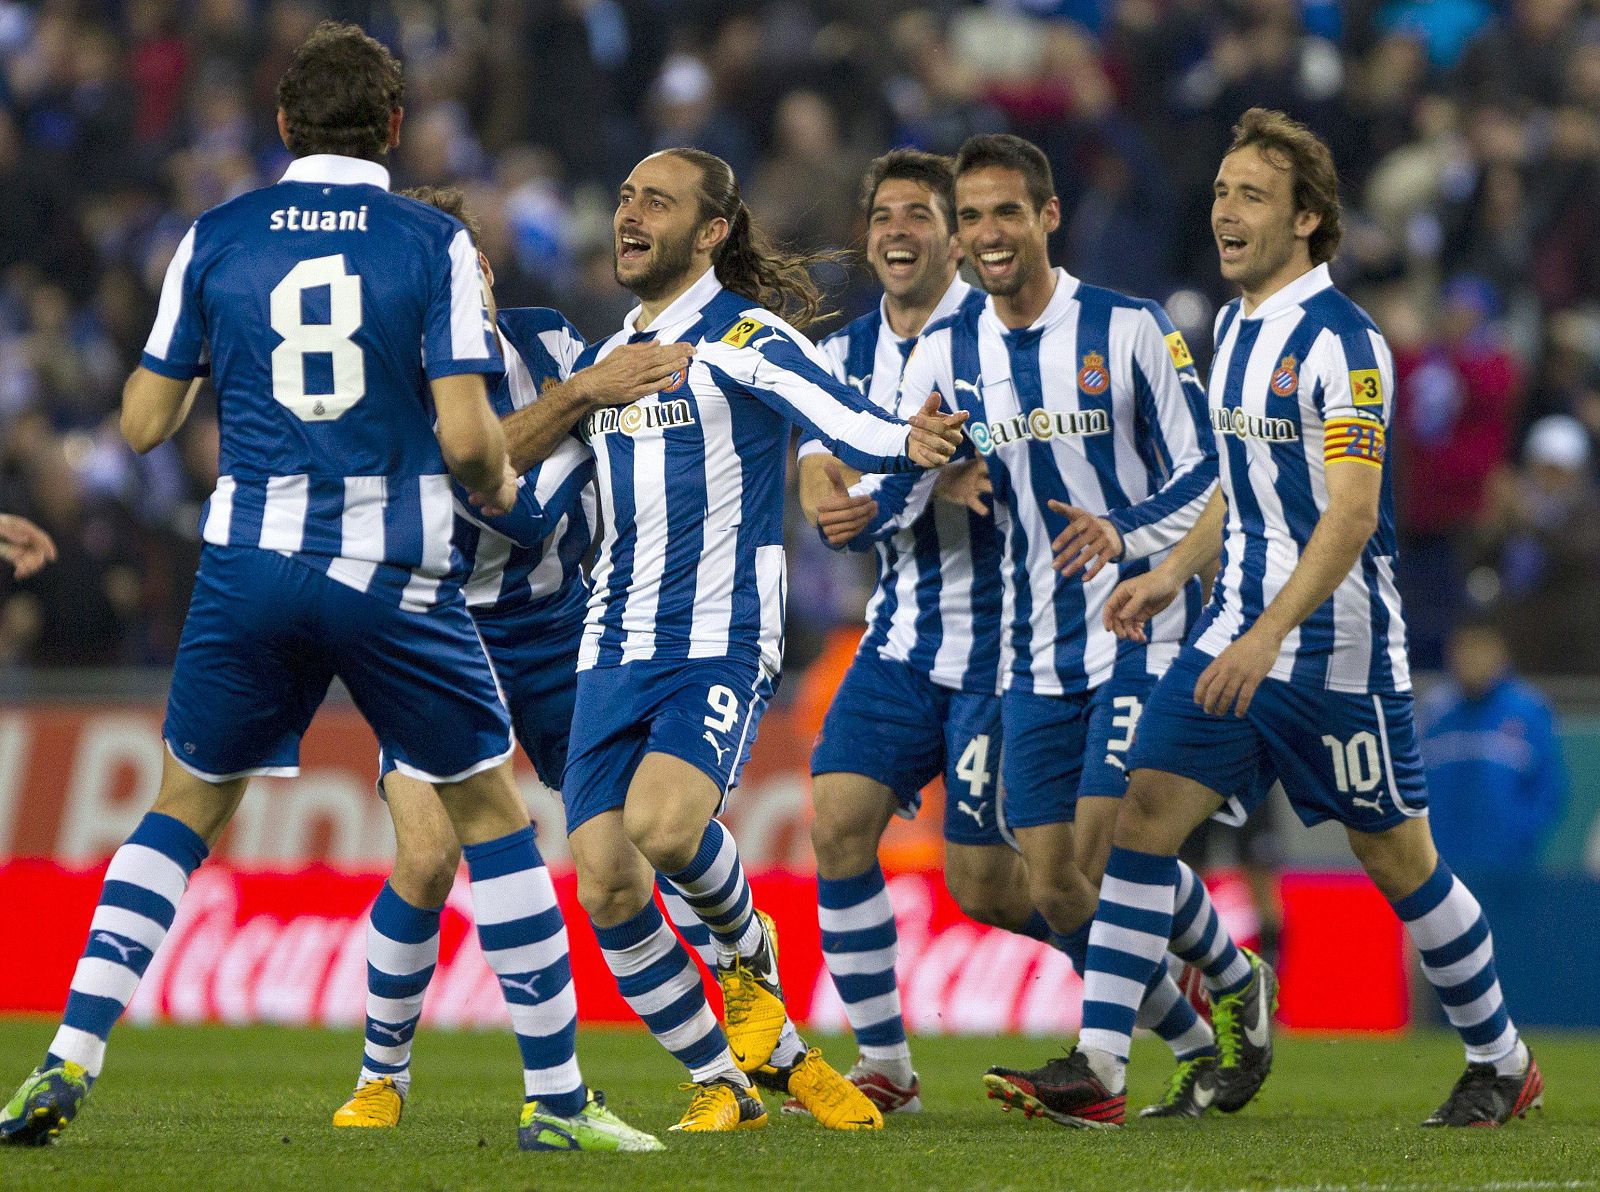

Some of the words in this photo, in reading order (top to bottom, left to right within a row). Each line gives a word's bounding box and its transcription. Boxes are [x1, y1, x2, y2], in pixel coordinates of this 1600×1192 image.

[270, 205, 369, 231] stuani
[270, 253, 366, 421] 8
[1363, 376, 1378, 398] 3
[1345, 424, 1377, 457] 21
[703, 684, 739, 734] 9
[1106, 695, 1144, 752] 3
[955, 733, 992, 797] 4
[1321, 730, 1382, 793] 10
